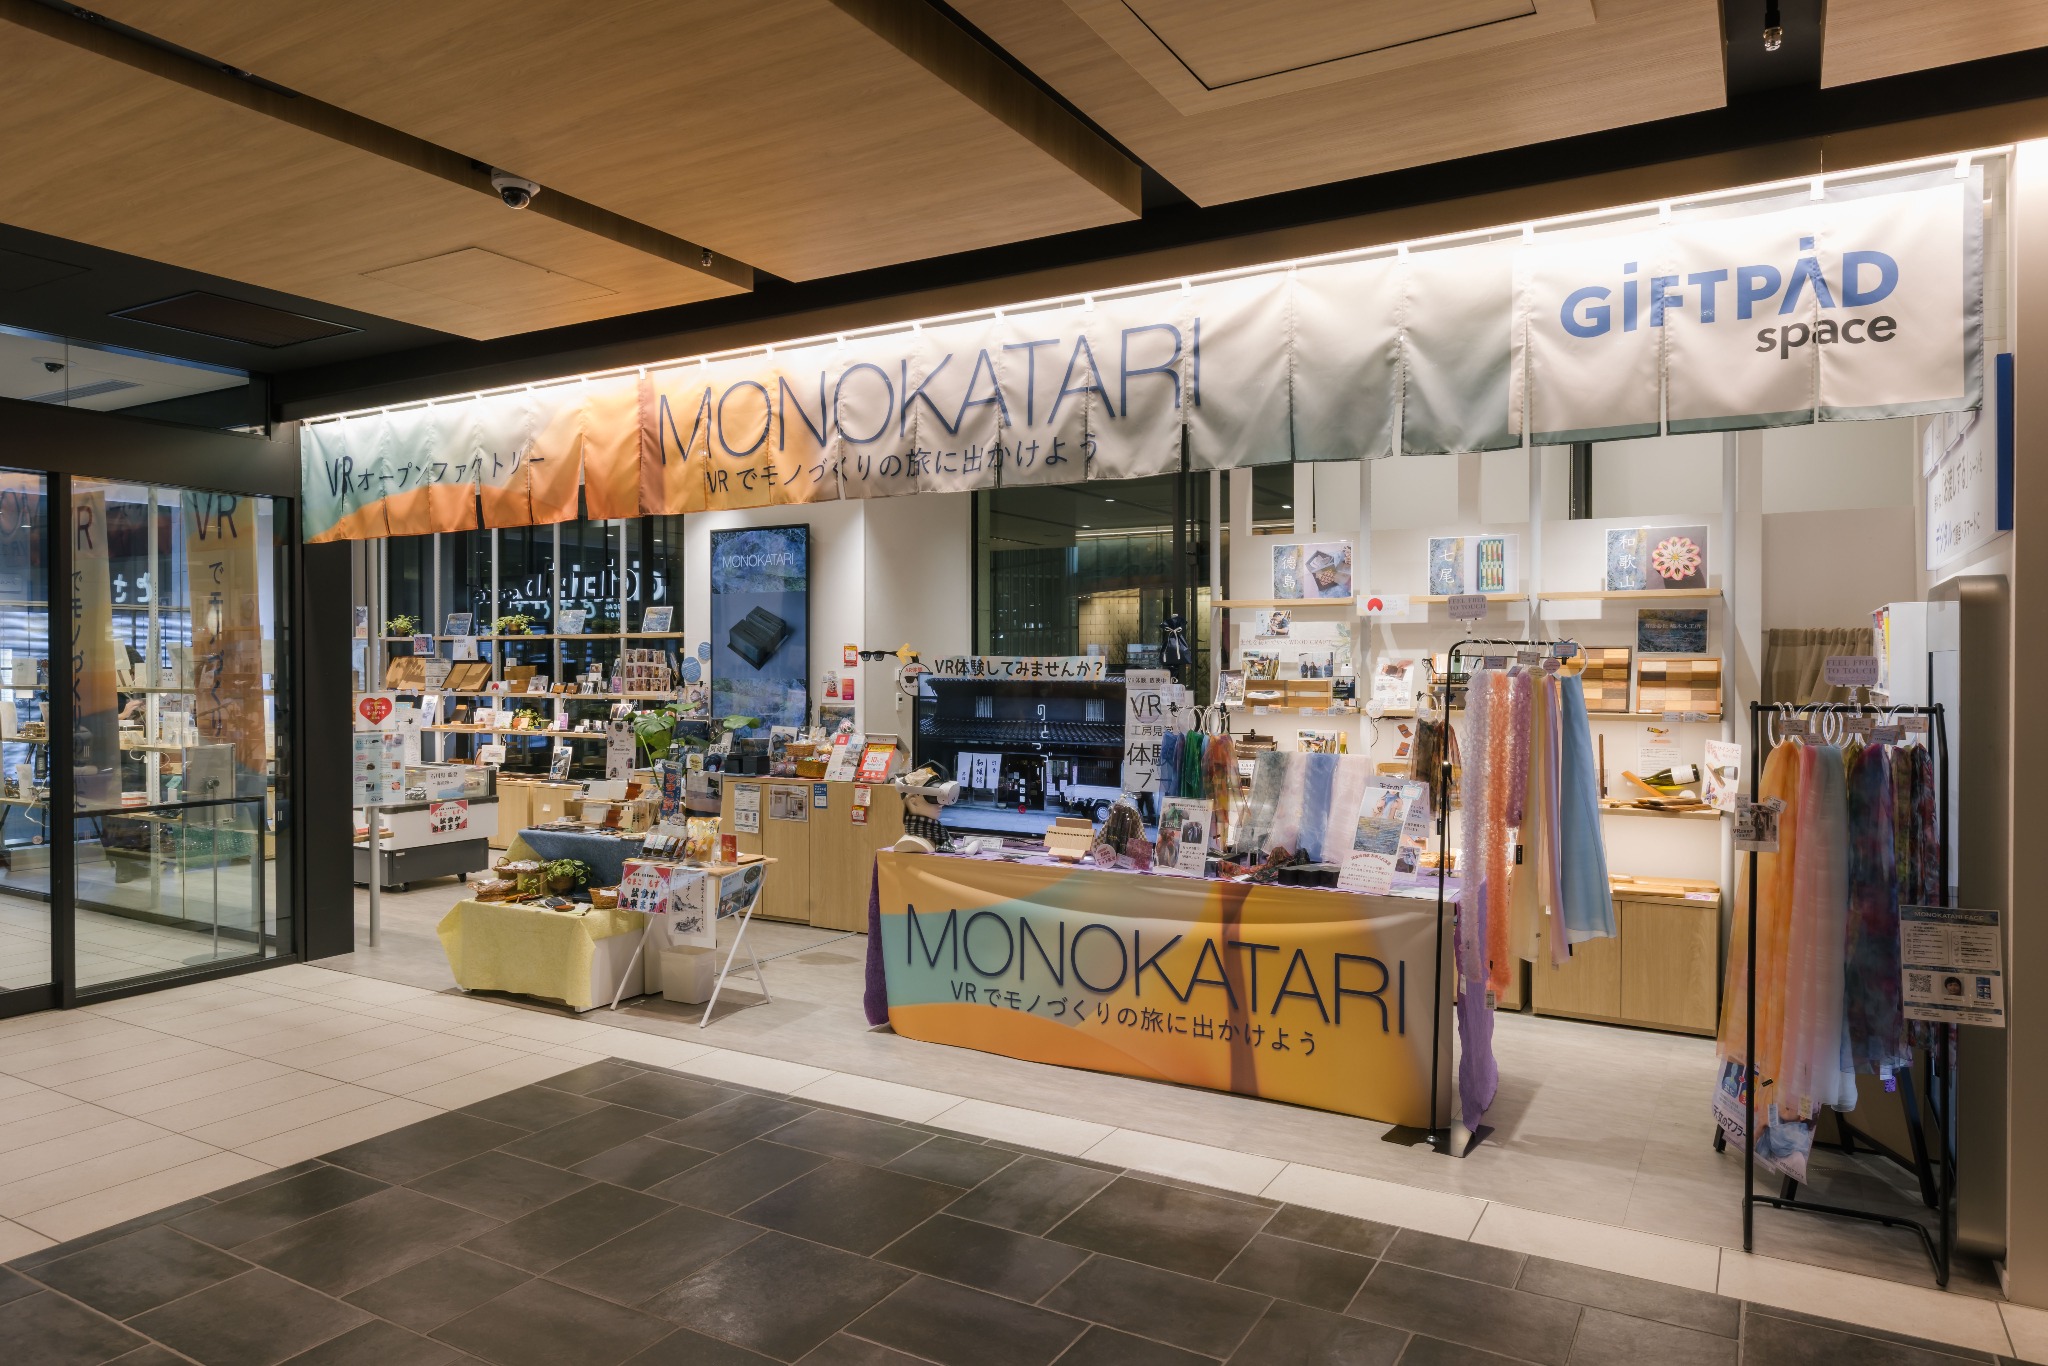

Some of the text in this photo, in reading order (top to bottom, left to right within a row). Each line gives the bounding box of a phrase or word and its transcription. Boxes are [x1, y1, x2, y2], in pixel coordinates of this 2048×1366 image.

[1755, 315, 1897, 360] space
[660, 317, 1200, 465] MONOKATARI
[192, 492, 238, 541] VR
[722, 552, 794, 568] MONOKATARI
[1281, 555, 1296, 589] 徳島
[1438, 549, 1455, 584] 七尾
[1619, 534, 1637, 588] 和歌山
[1130, 694, 1162, 717] VR
[627, 878, 642, 886] なまこ
[630, 887, 658, 900] 試食が
[1914, 911, 1963, 920] MONOKATARI
[907, 903, 1406, 1036] MONOKATARI
